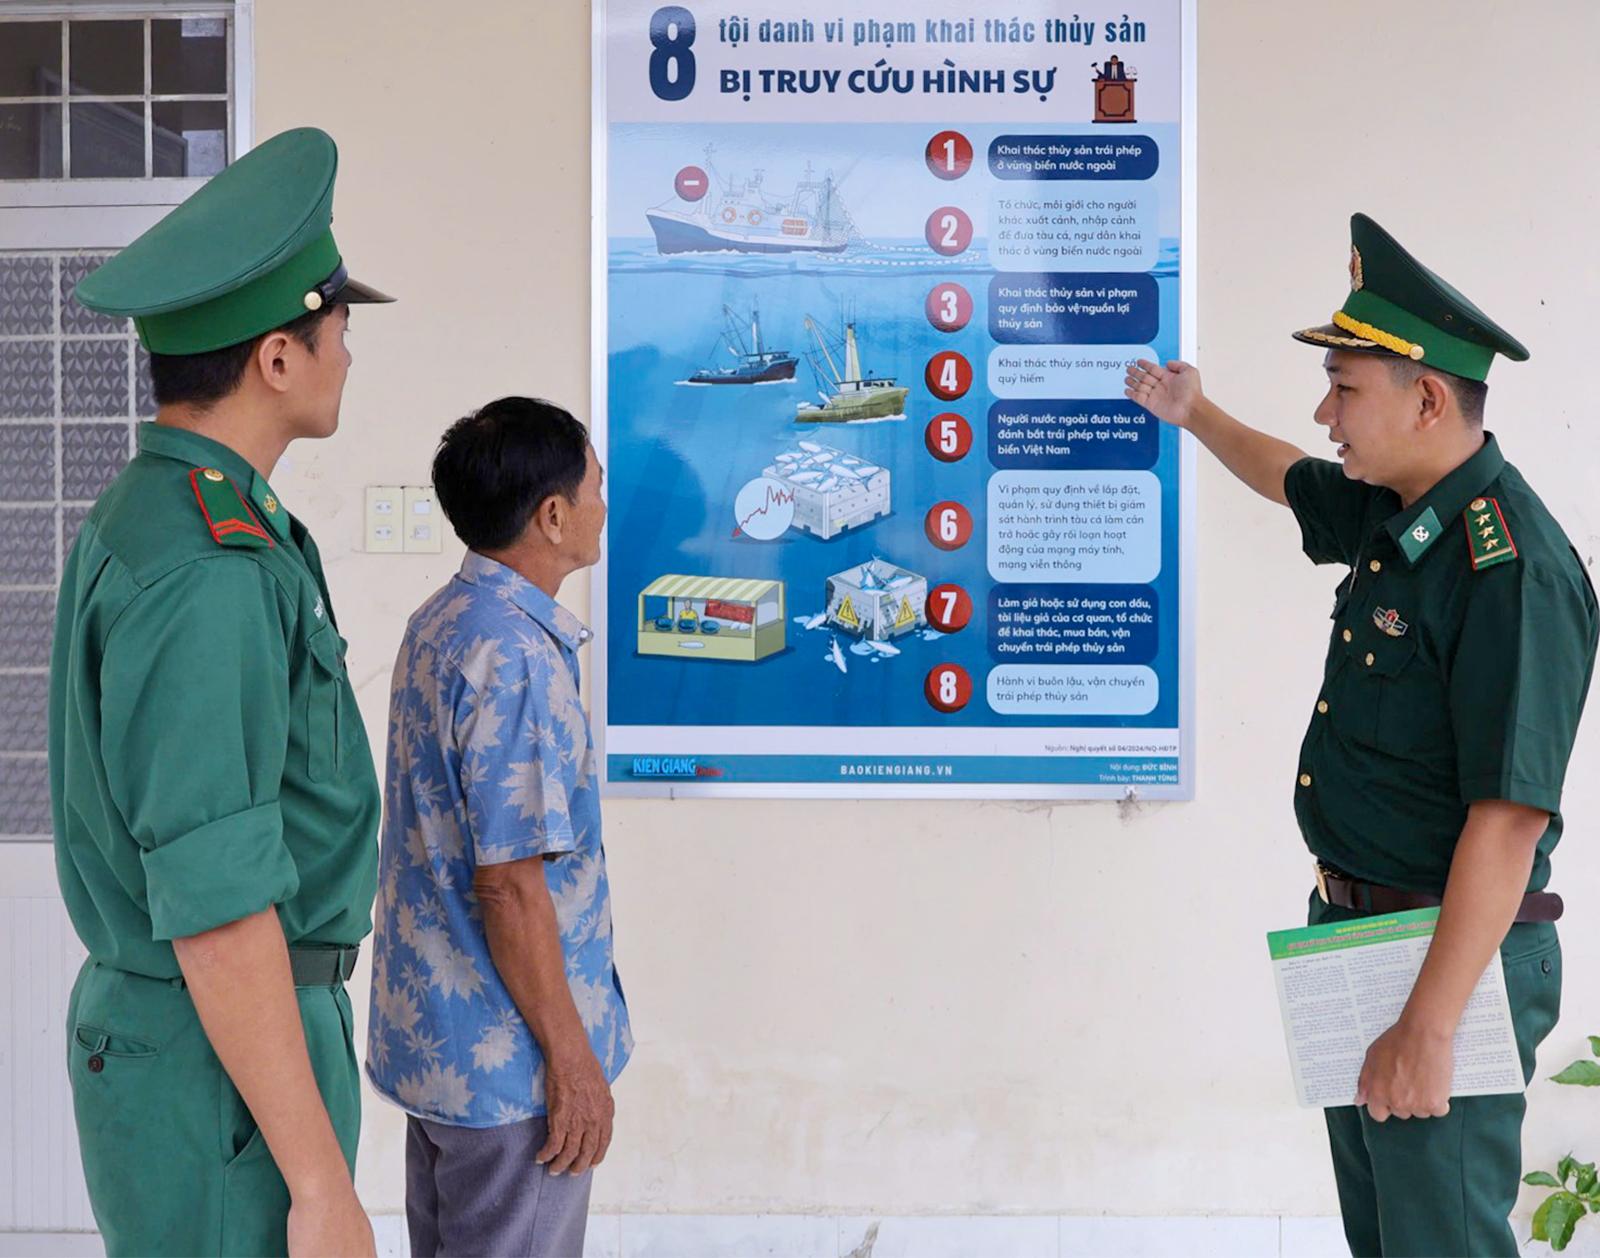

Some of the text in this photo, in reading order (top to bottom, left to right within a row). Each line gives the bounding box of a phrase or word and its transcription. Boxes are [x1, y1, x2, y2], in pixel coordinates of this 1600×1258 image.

[719, 14, 1146, 48] tội danh vi phạm khai thác thủy sản
[649, 6, 696, 101] 8
[720, 58, 1057, 102] BỊ TRUY CỨU HÌNH SỰ
[942, 139, 955, 171] 1
[998, 145, 1141, 157] Khai thác thủy sản trái phép
[997, 160, 1004, 169] ở
[1007, 161, 1032, 172] vùng
[1059, 160, 1084, 170] nước
[1087, 160, 1116, 172] ngoài
[1087, 200, 1104, 209] cho
[941, 214, 958, 248] 2
[1120, 231, 1141, 240] khai
[998, 287, 1137, 299] Khai thác thủy sản vi phạm
[941, 291, 958, 323] 3
[998, 305, 1017, 315] quy
[1020, 303, 1042, 314] định
[1045, 303, 1065, 312] bảo
[1068, 303, 1079, 313] vệ
[1117, 303, 1129, 315] lợi
[998, 318, 1042, 330] thủy sản
[998, 358, 1021, 367] Khai
[1097, 361, 1122, 370] nguy
[940, 359, 958, 392] 4
[998, 414, 1145, 426] Người nước ngoài đưa tàu cá
[940, 421, 958, 454] 5
[998, 429, 1024, 439] đánh
[1047, 429, 1065, 439] trái
[1068, 430, 1093, 441] phép
[1096, 430, 1109, 441] tại
[1112, 429, 1138, 441] vùng
[1023, 444, 1043, 456] Việt
[1046, 445, 1070, 454] Nam
[999, 485, 1008, 493] Vi
[1043, 487, 1061, 496] quy
[940, 509, 958, 542] 6
[940, 591, 958, 625] 7
[998, 598, 1020, 607] Làm
[1022, 597, 1038, 609] giả
[1081, 599, 1106, 610] dụng
[998, 612, 1011, 622] tài
[1014, 613, 1031, 624] liệu
[1034, 613, 1049, 624] giả
[1052, 613, 1070, 622] của
[1072, 614, 1084, 622] cơ
[1087, 615, 1114, 624] quan,
[1129, 613, 1152, 623] chức
[1013, 628, 1034, 637] khai
[1037, 627, 1061, 637] thác,
[1088, 627, 1109, 637] bán,
[1112, 627, 1130, 639] vận
[1035, 642, 1053, 652] trái
[1055, 642, 1080, 654] phép
[1083, 642, 1105, 654] thủy
[1107, 642, 1125, 652] sản
[1027, 676, 1035, 685] vi
[939, 671, 957, 704] 8
[840, 765, 953, 776] BAOKIENGIANG.VN
